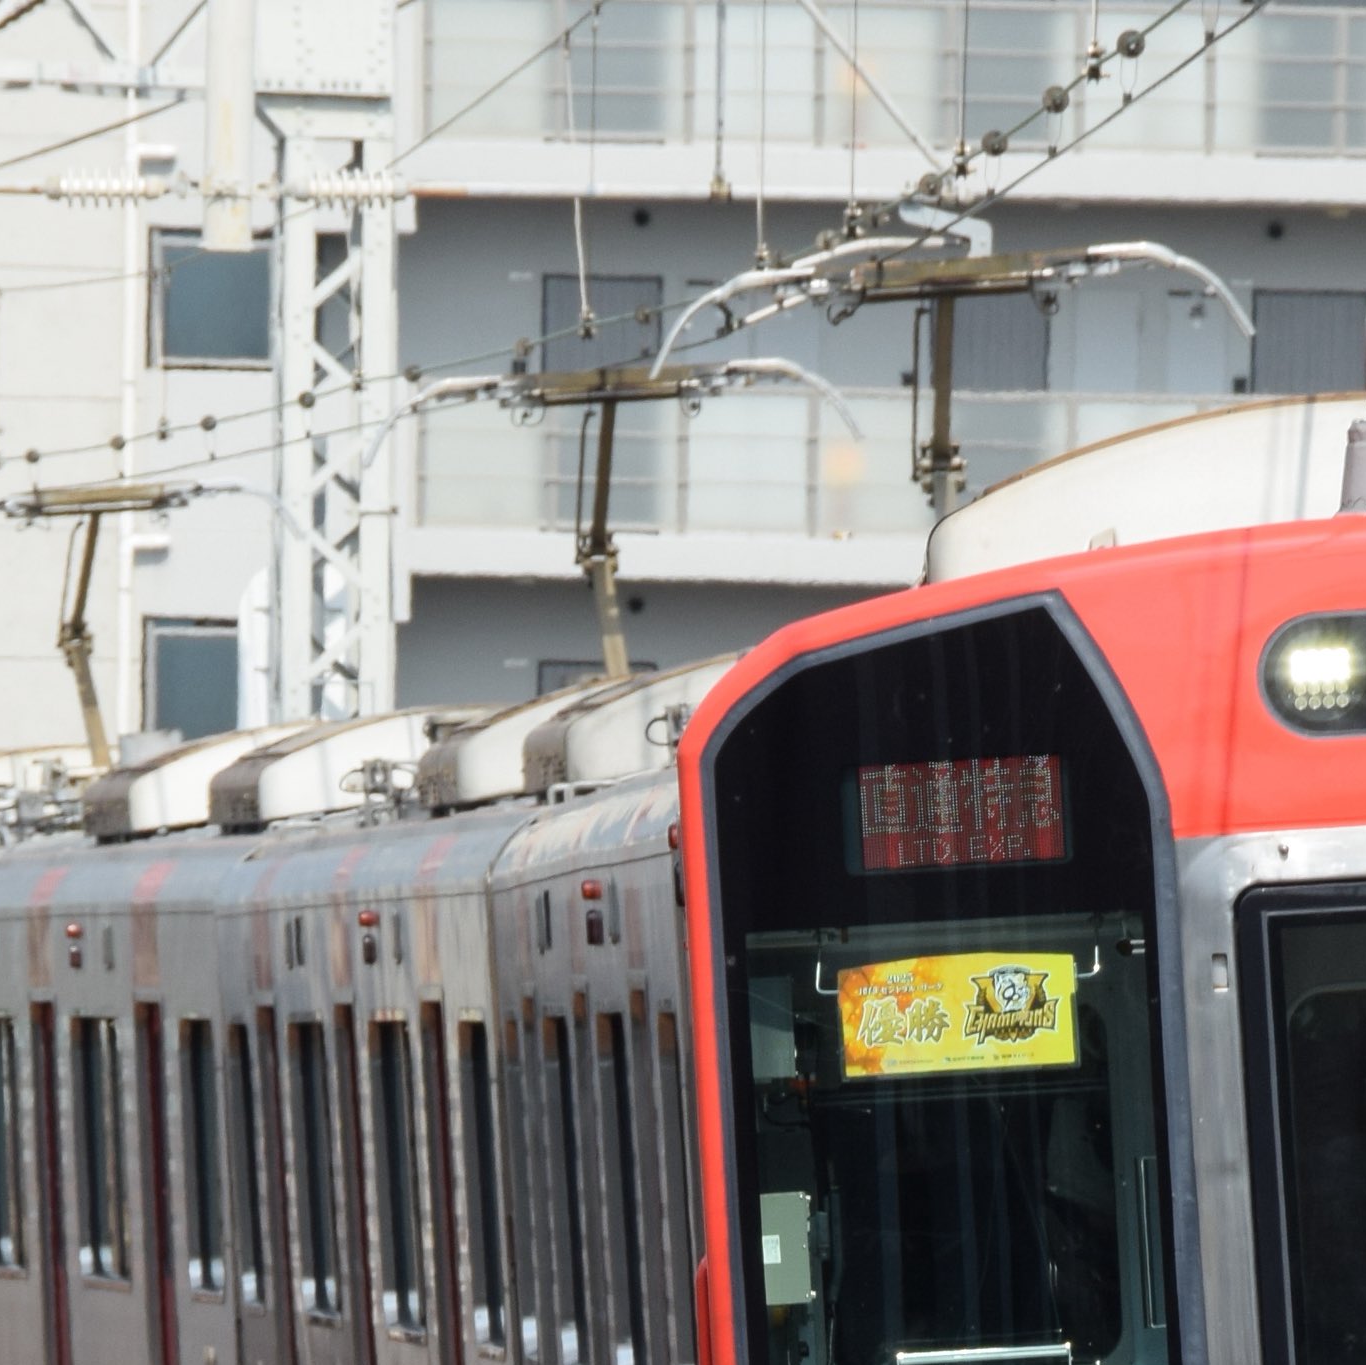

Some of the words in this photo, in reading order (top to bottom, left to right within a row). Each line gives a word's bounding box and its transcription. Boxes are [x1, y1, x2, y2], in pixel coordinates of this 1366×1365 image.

[859, 753, 1060, 838] 直通特急
[898, 837, 959, 865] LTD.
[970, 834, 1031, 861] EXP.
[857, 996, 951, 1047] 優勝
